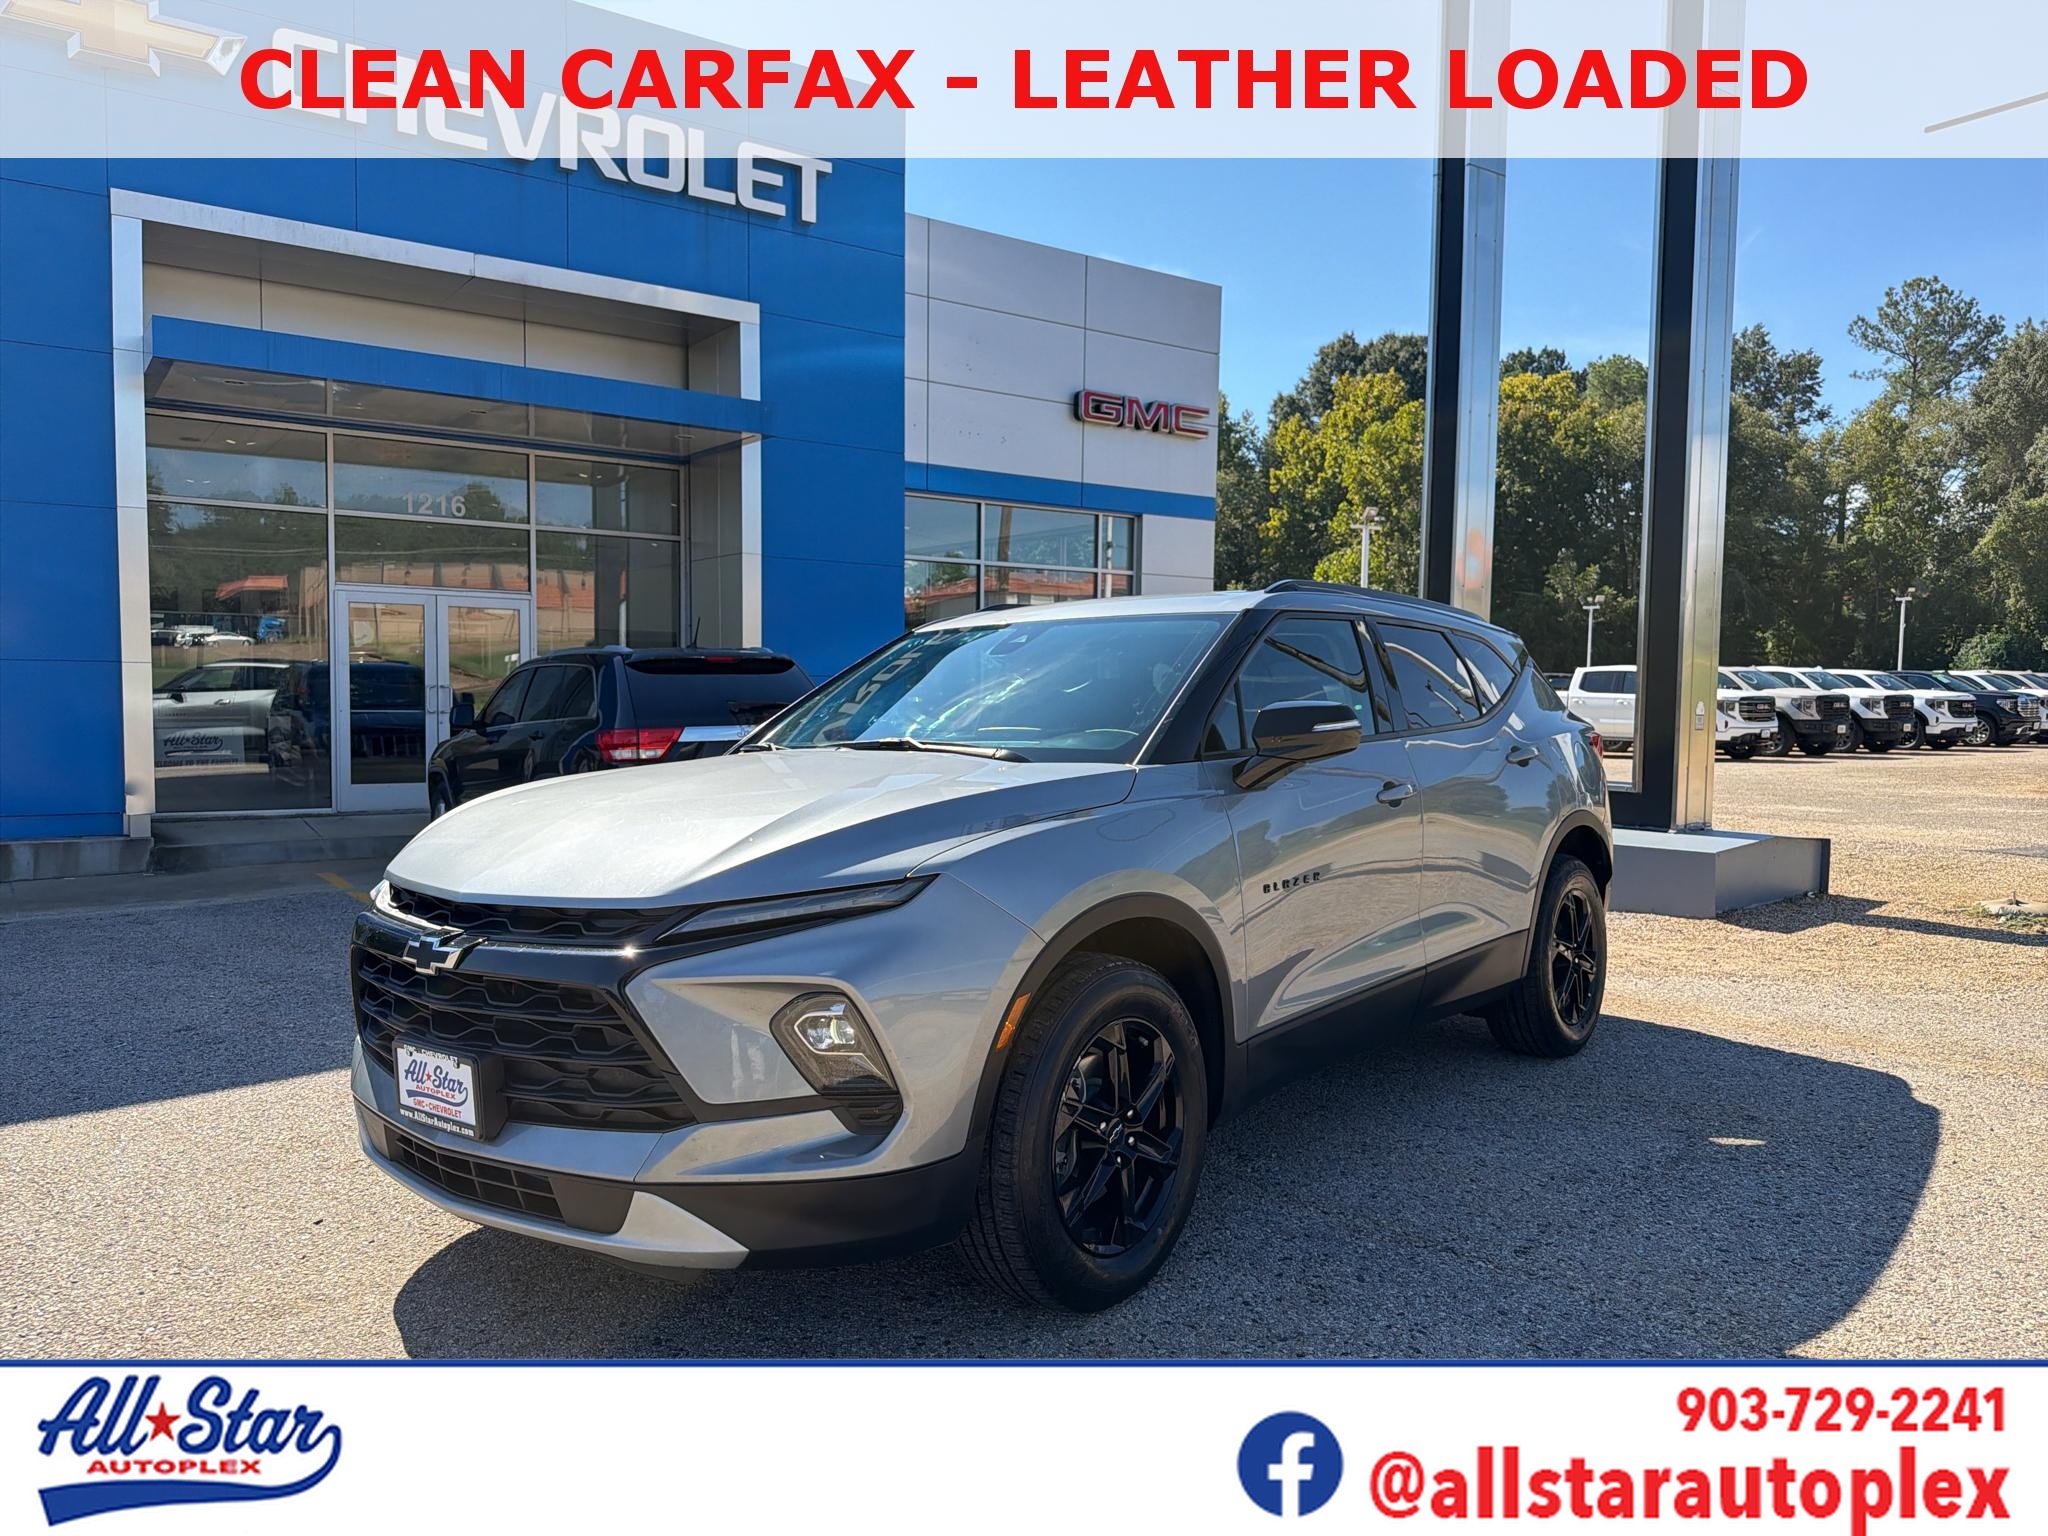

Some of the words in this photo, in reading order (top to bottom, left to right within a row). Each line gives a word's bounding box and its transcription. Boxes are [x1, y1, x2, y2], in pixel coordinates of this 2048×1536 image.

[1078, 389, 1210, 439] GMC
[403, 490, 467, 518] 1216
[1263, 872, 1320, 893] BLAZER
[404, 1059, 427, 1085] All
[432, 1065, 468, 1095] Star
[415, 1084, 457, 1100] AUTOPLEX
[412, 1097, 426, 1109] GMC
[428, 1102, 462, 1119] CHEVROLET
